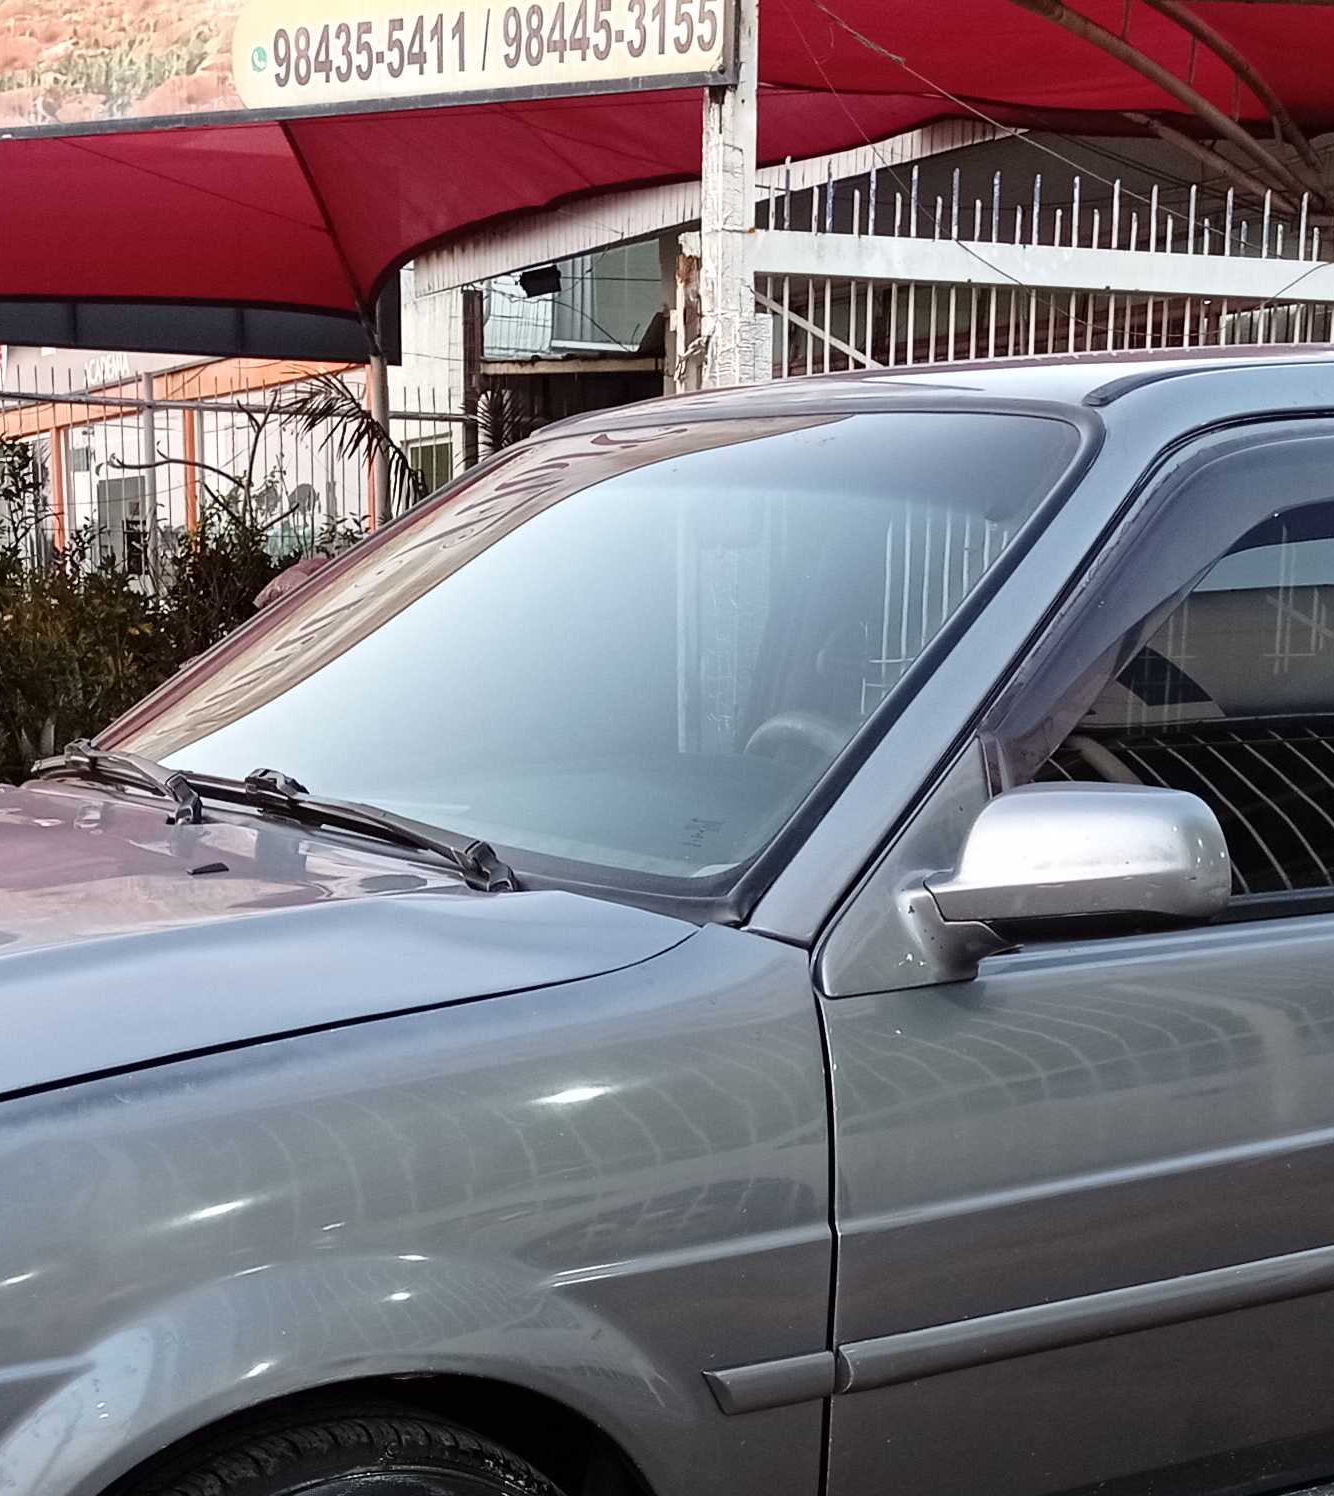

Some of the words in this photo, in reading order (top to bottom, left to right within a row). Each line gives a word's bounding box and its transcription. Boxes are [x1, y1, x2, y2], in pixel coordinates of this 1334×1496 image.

[273, 11, 466, 87] 98435-5411
[481, 8, 491, 71] /
[503, 0, 718, 68] 98445-3155
